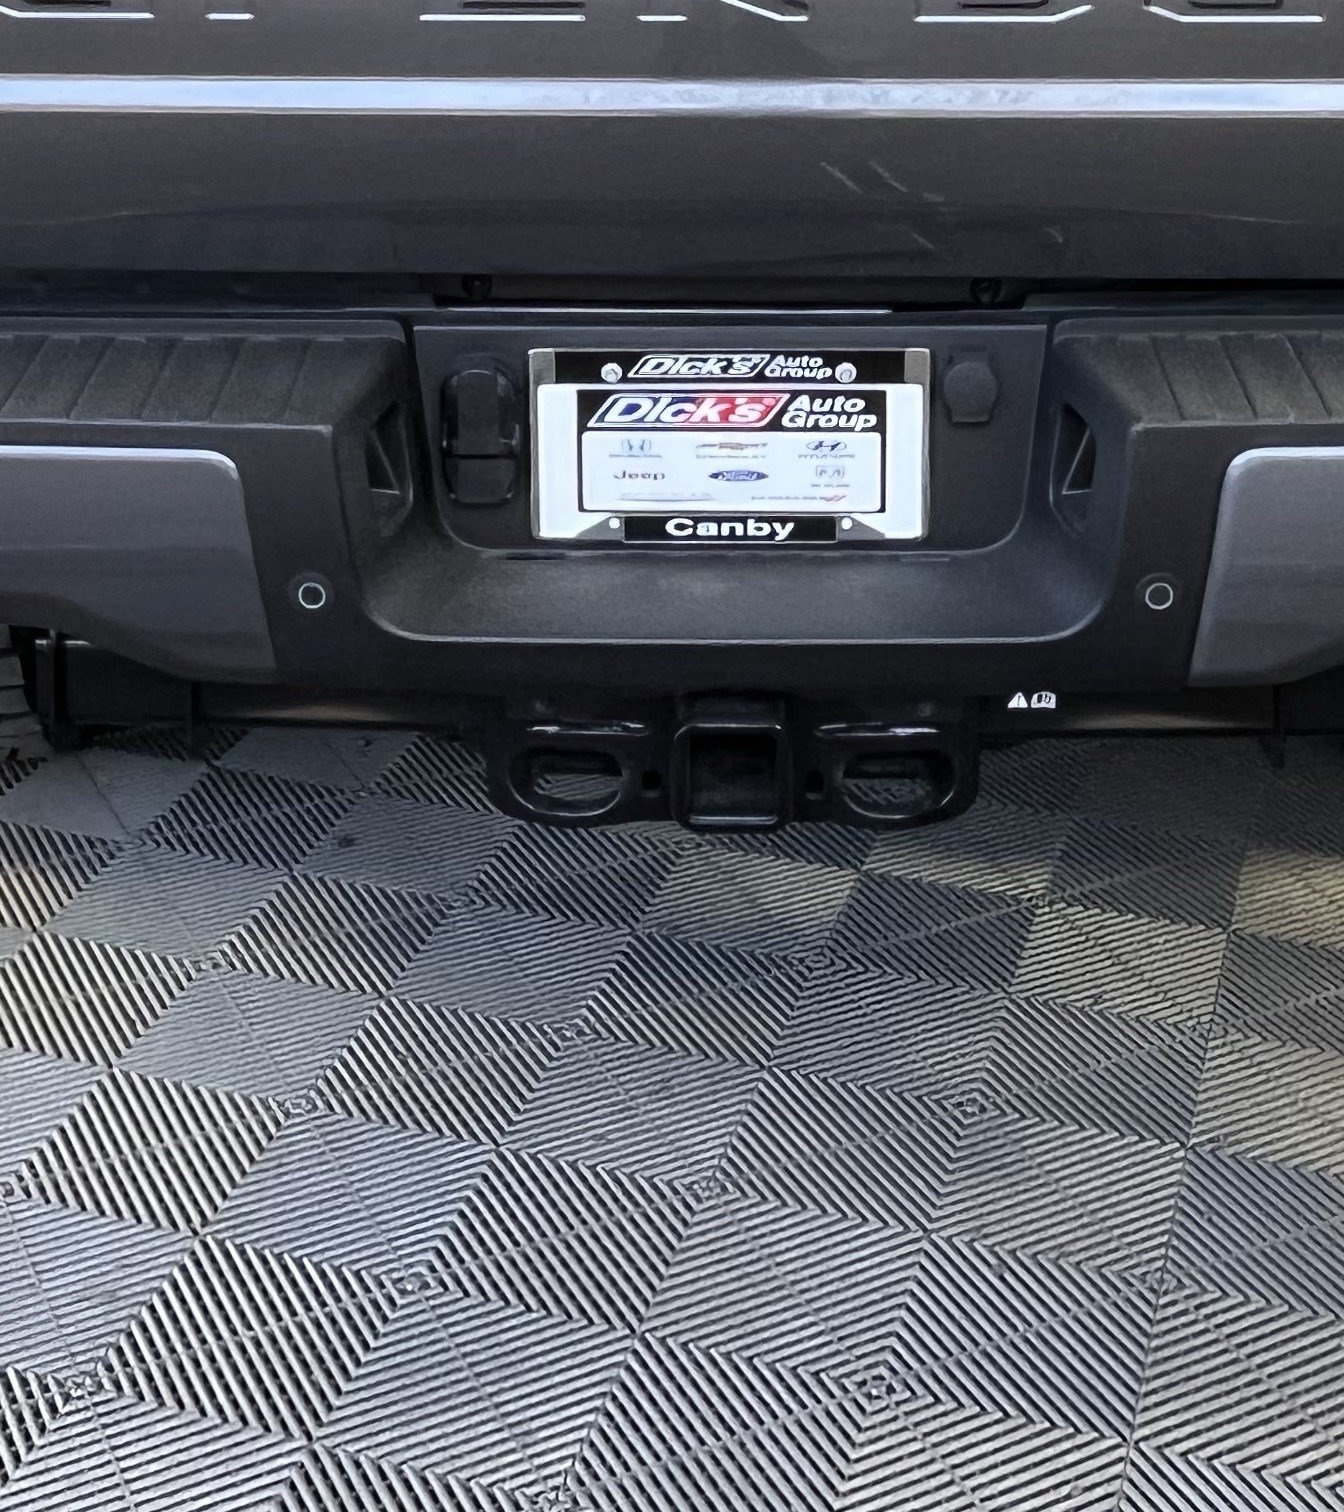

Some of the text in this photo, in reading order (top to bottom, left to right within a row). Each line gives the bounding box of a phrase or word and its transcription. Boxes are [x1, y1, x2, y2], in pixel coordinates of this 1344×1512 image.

[774, 354, 824, 368] Auto
[763, 366, 833, 380] Group
[786, 394, 866, 413] Auto
[781, 410, 878, 432] Group
[664, 517, 795, 542] Canby
